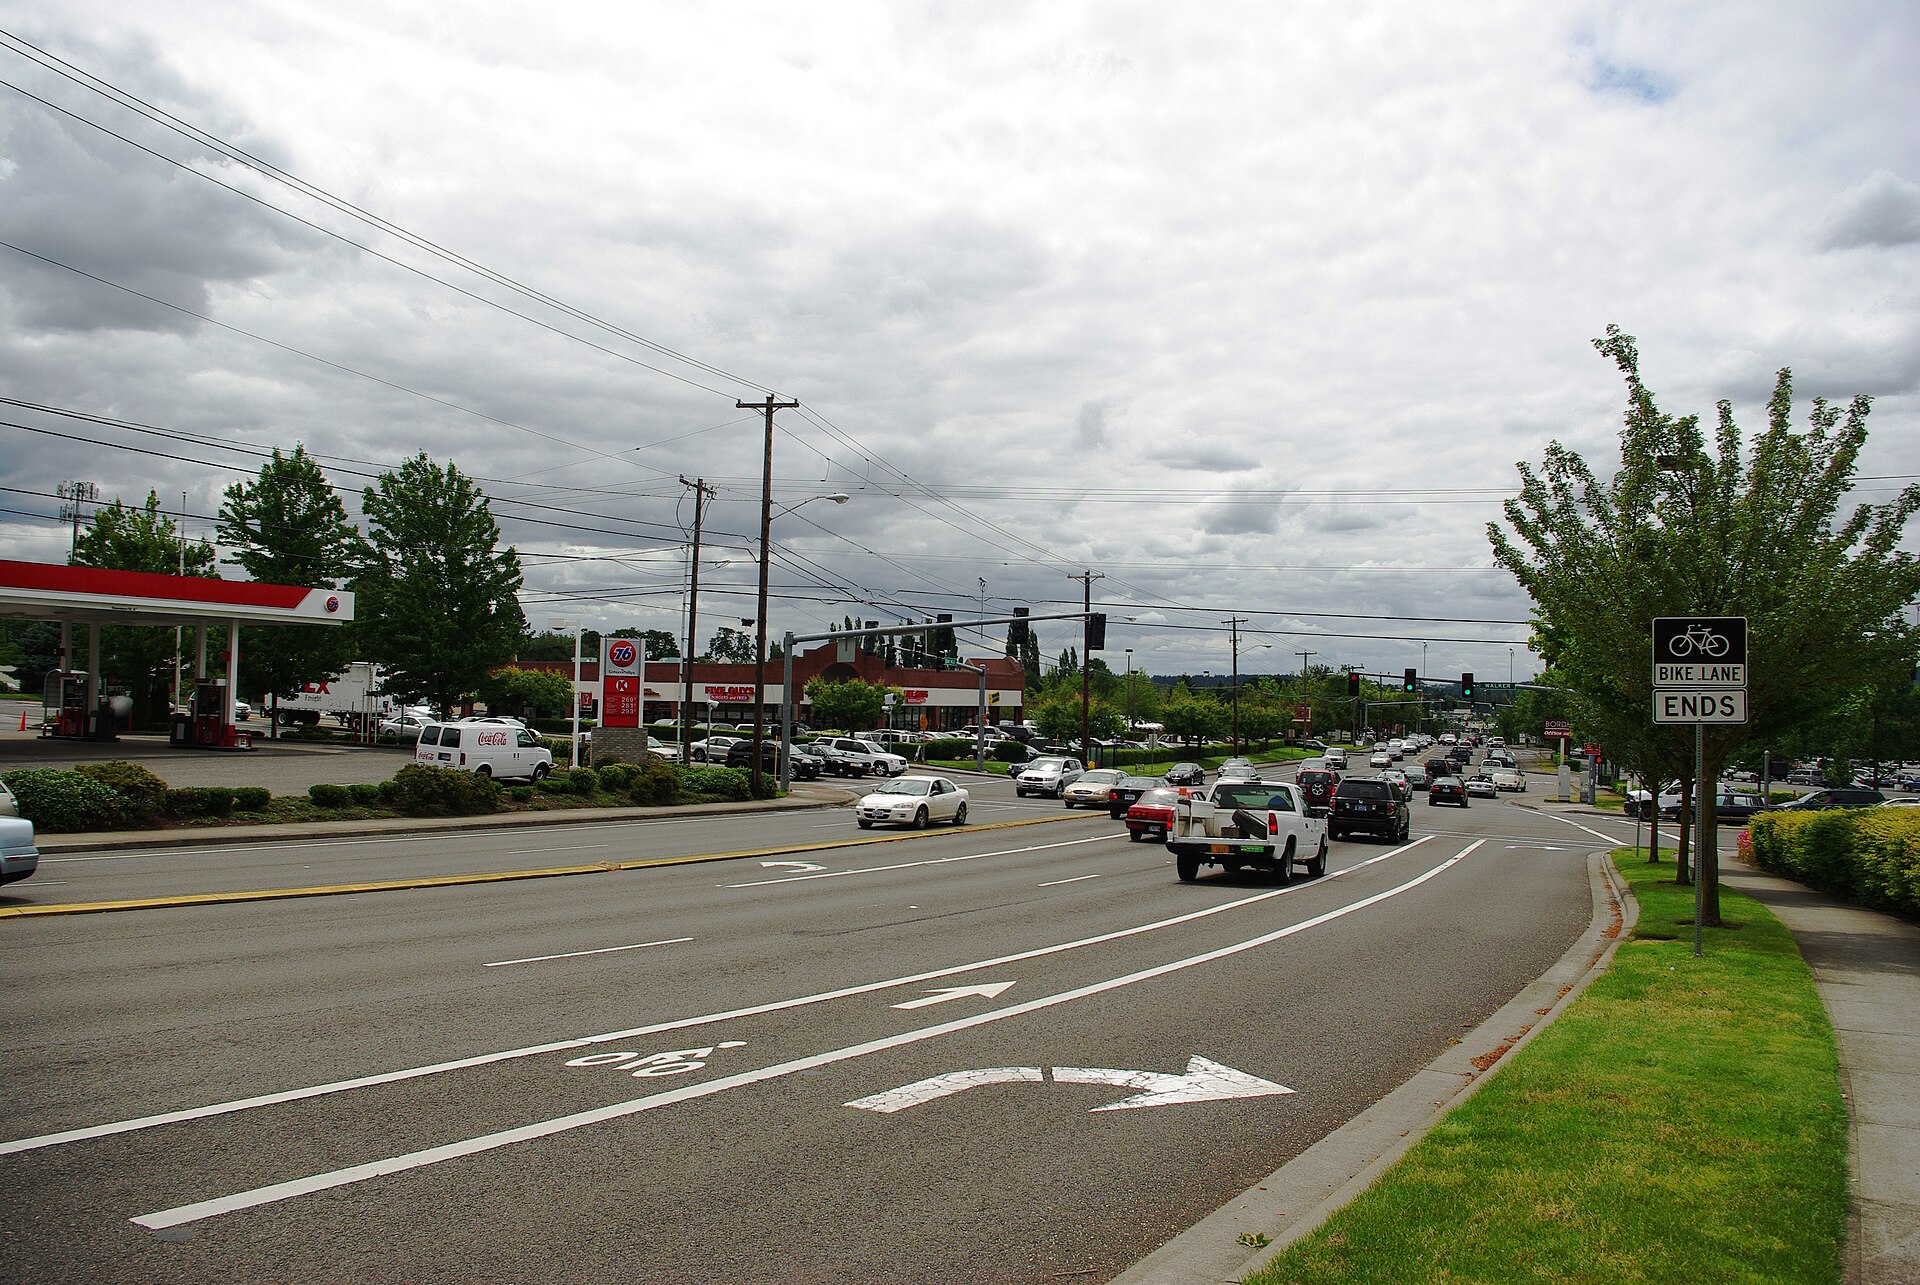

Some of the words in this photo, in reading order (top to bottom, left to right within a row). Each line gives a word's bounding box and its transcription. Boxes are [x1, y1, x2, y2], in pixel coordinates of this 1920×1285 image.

[614, 646, 632, 661] 76
[1660, 666, 1694, 680] BIKE
[1701, 666, 1740, 681] LANE
[705, 686, 725, 694] FIVE
[728, 686, 754, 695] GUYS
[1664, 695, 1735, 717] ENDS
